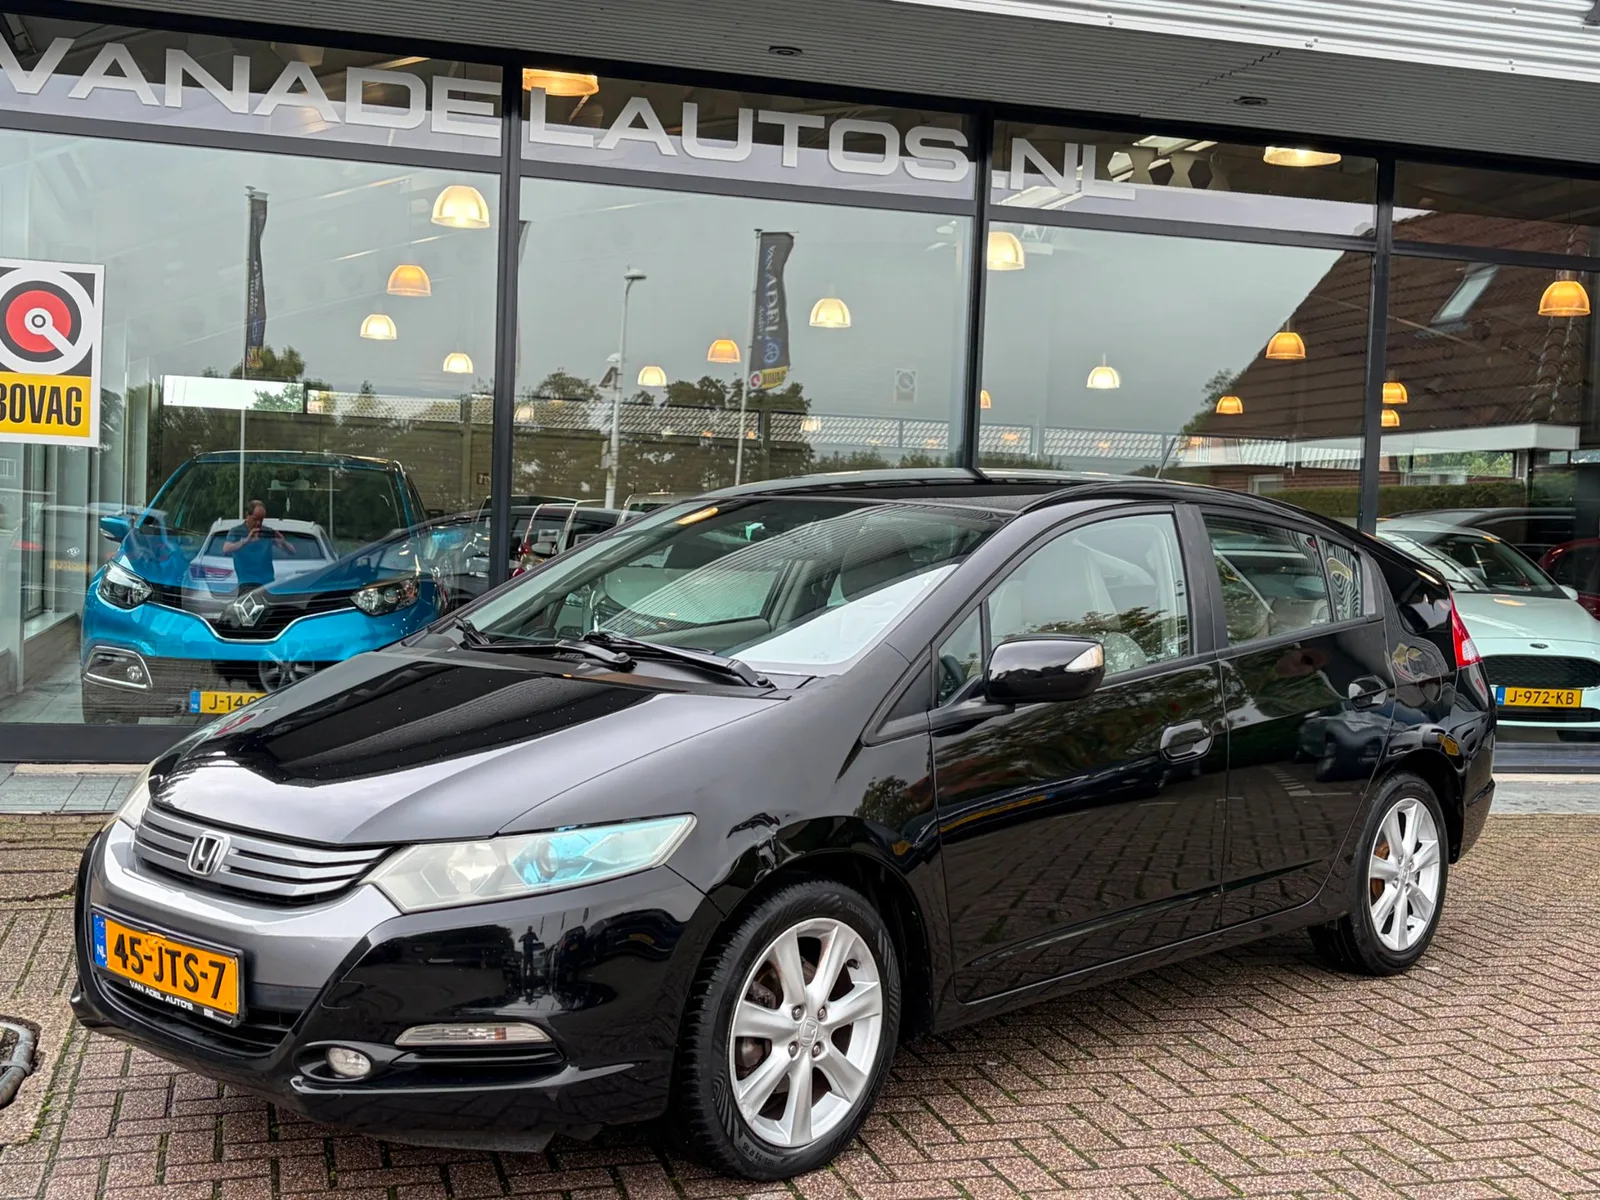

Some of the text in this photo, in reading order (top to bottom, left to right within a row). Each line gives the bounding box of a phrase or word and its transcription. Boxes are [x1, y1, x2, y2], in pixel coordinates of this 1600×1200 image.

[1509, 690, 1575, 705] J-972-KB
[113, 933, 226, 1000] 45-JTS-7
[129, 980, 144, 993] VAN
